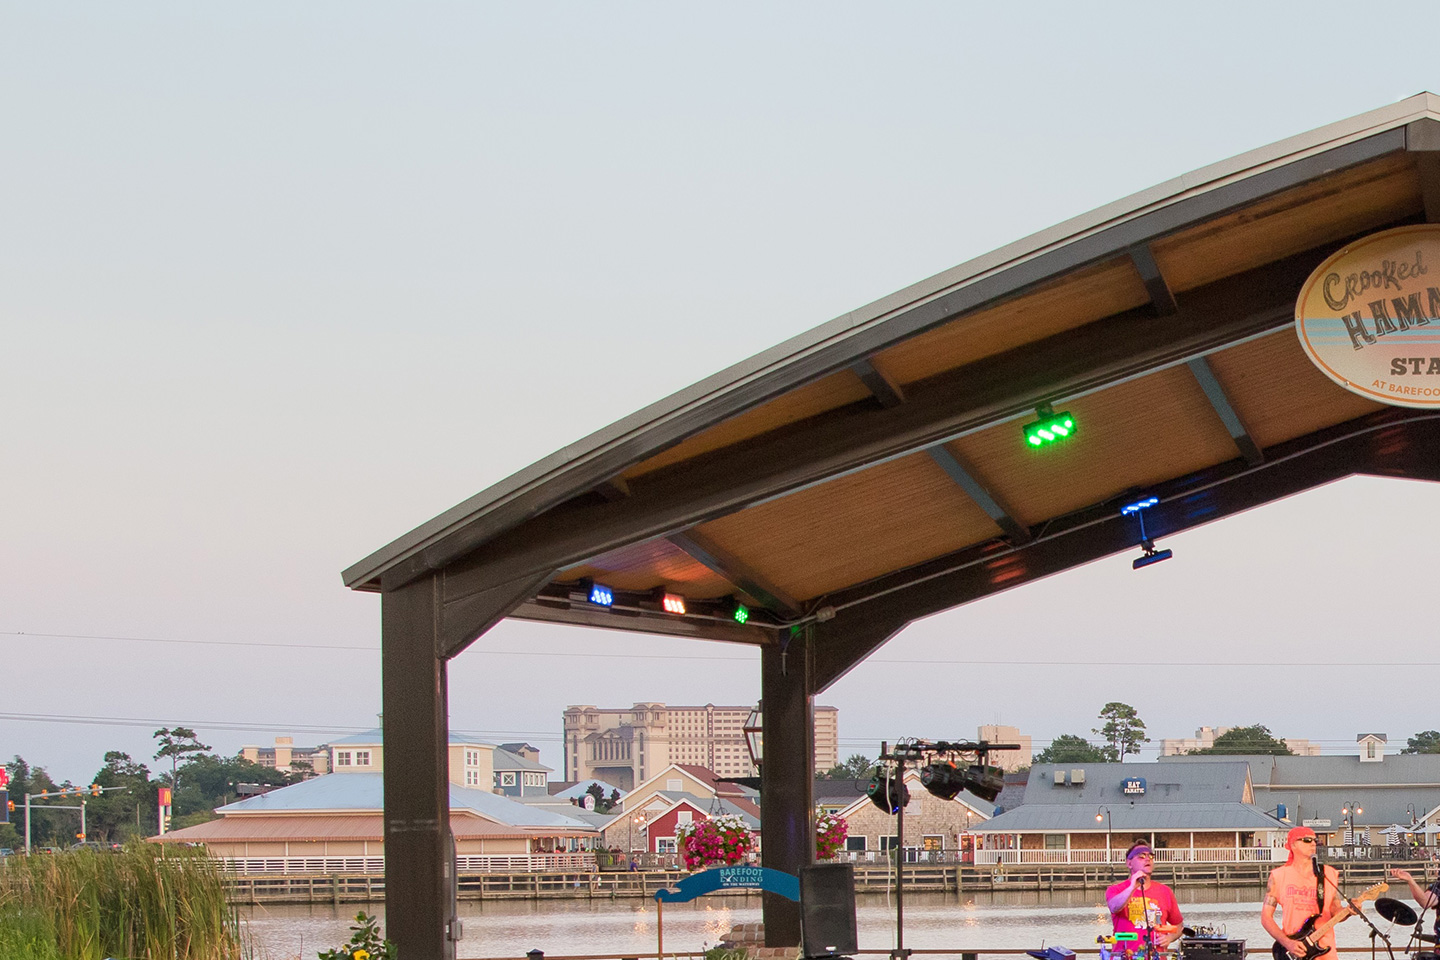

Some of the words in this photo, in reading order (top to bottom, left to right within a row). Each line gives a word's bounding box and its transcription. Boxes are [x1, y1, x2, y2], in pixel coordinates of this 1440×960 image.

[1322, 250, 1428, 312] Crooked
[1372, 379, 1388, 390] AT
[720, 868, 764, 876] BAREFOOT
